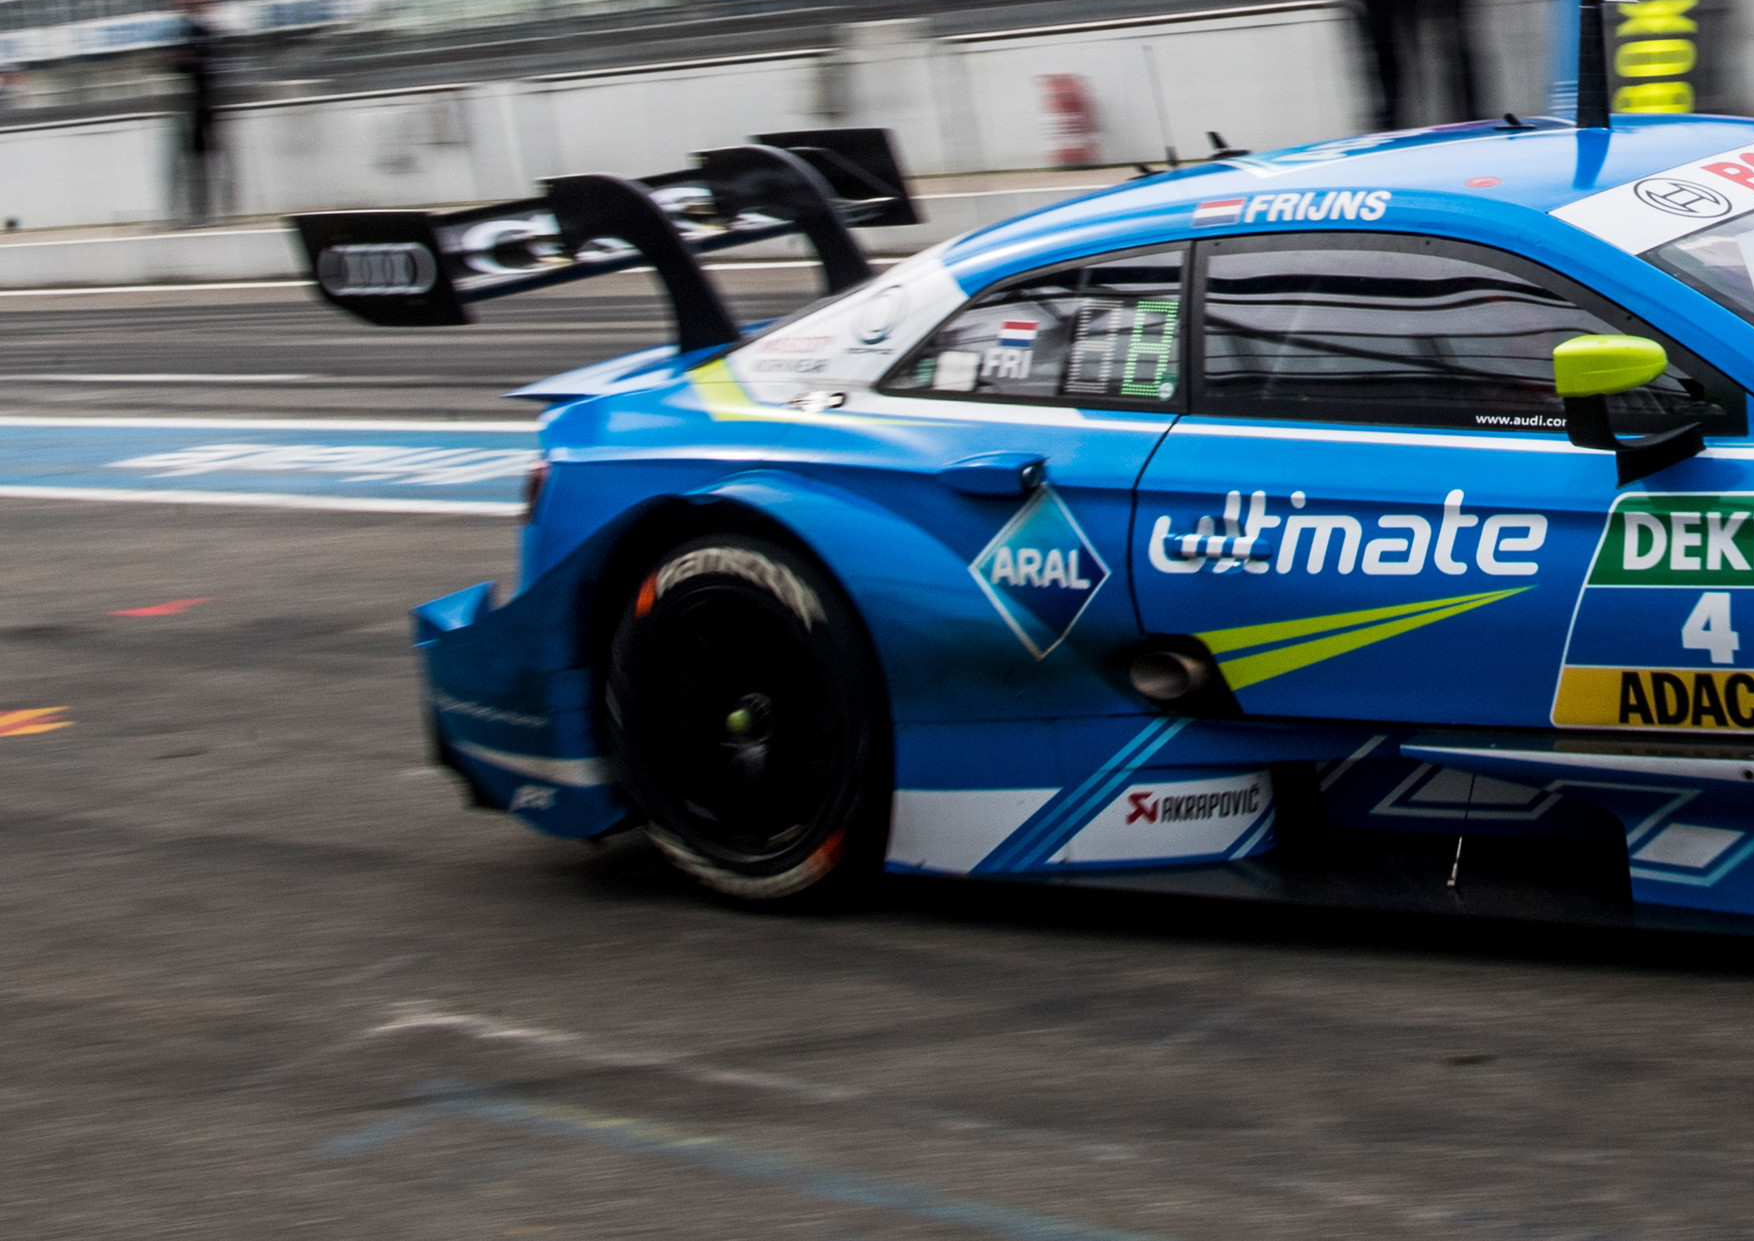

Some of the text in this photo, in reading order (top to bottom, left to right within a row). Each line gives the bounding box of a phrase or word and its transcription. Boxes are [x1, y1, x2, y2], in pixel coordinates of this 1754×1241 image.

[1244, 190, 1391, 223] FRIJNS
[981, 348, 1034, 379] FRI
[1148, 488, 1549, 575] ultimate
[990, 545, 1091, 590] ARAL
[1681, 591, 1740, 665] 4
